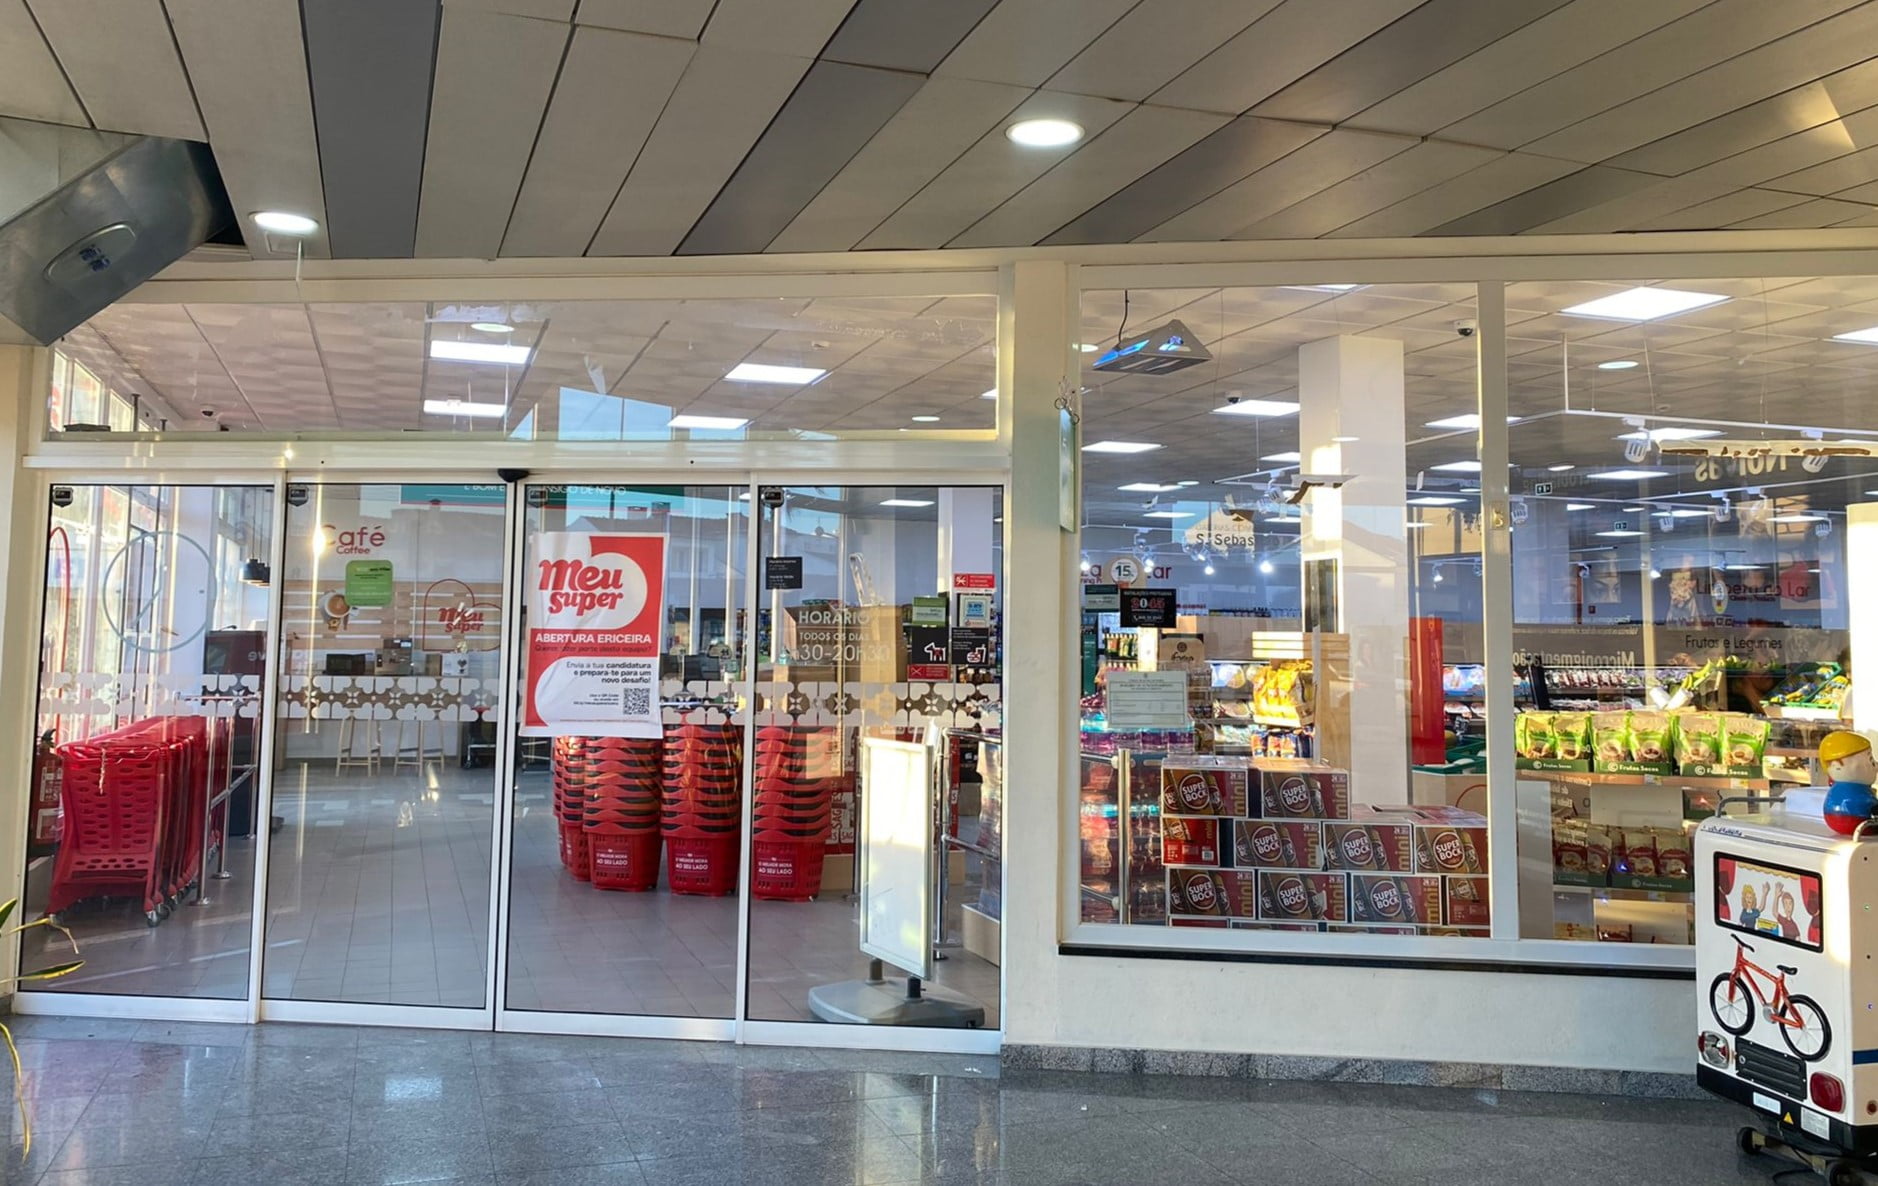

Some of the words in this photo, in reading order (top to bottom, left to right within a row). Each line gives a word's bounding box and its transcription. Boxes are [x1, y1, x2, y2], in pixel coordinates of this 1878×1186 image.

[336, 546, 370, 555] Coffee
[538, 559, 623, 592] Meu
[548, 591, 624, 617] super
[535, 633, 595, 643] ABERTURA
[597, 633, 653, 644] ERICEIRA
[800, 632, 831, 641] TODOS
[833, 632, 846, 641] OS
[1685, 635, 1717, 648] Frutas
[1733, 635, 1782, 651] Legumes
[566, 661, 585, 669] Envia
[592, 661, 605, 669] tua
[606, 661, 652, 669] candidatura
[580, 670, 619, 678] prepara-te
[1185, 789, 1207, 802] BOCK
[1285, 793, 1308, 805] BOCK
[1258, 842, 1280, 854] BOCK
[1347, 845, 1370, 858] BOCK
[1439, 848, 1463, 861] BOCK
[1191, 890, 1214, 902] BOCK
[1283, 893, 1306, 906] BOCK
[1376, 896, 1400, 909] BOCK
